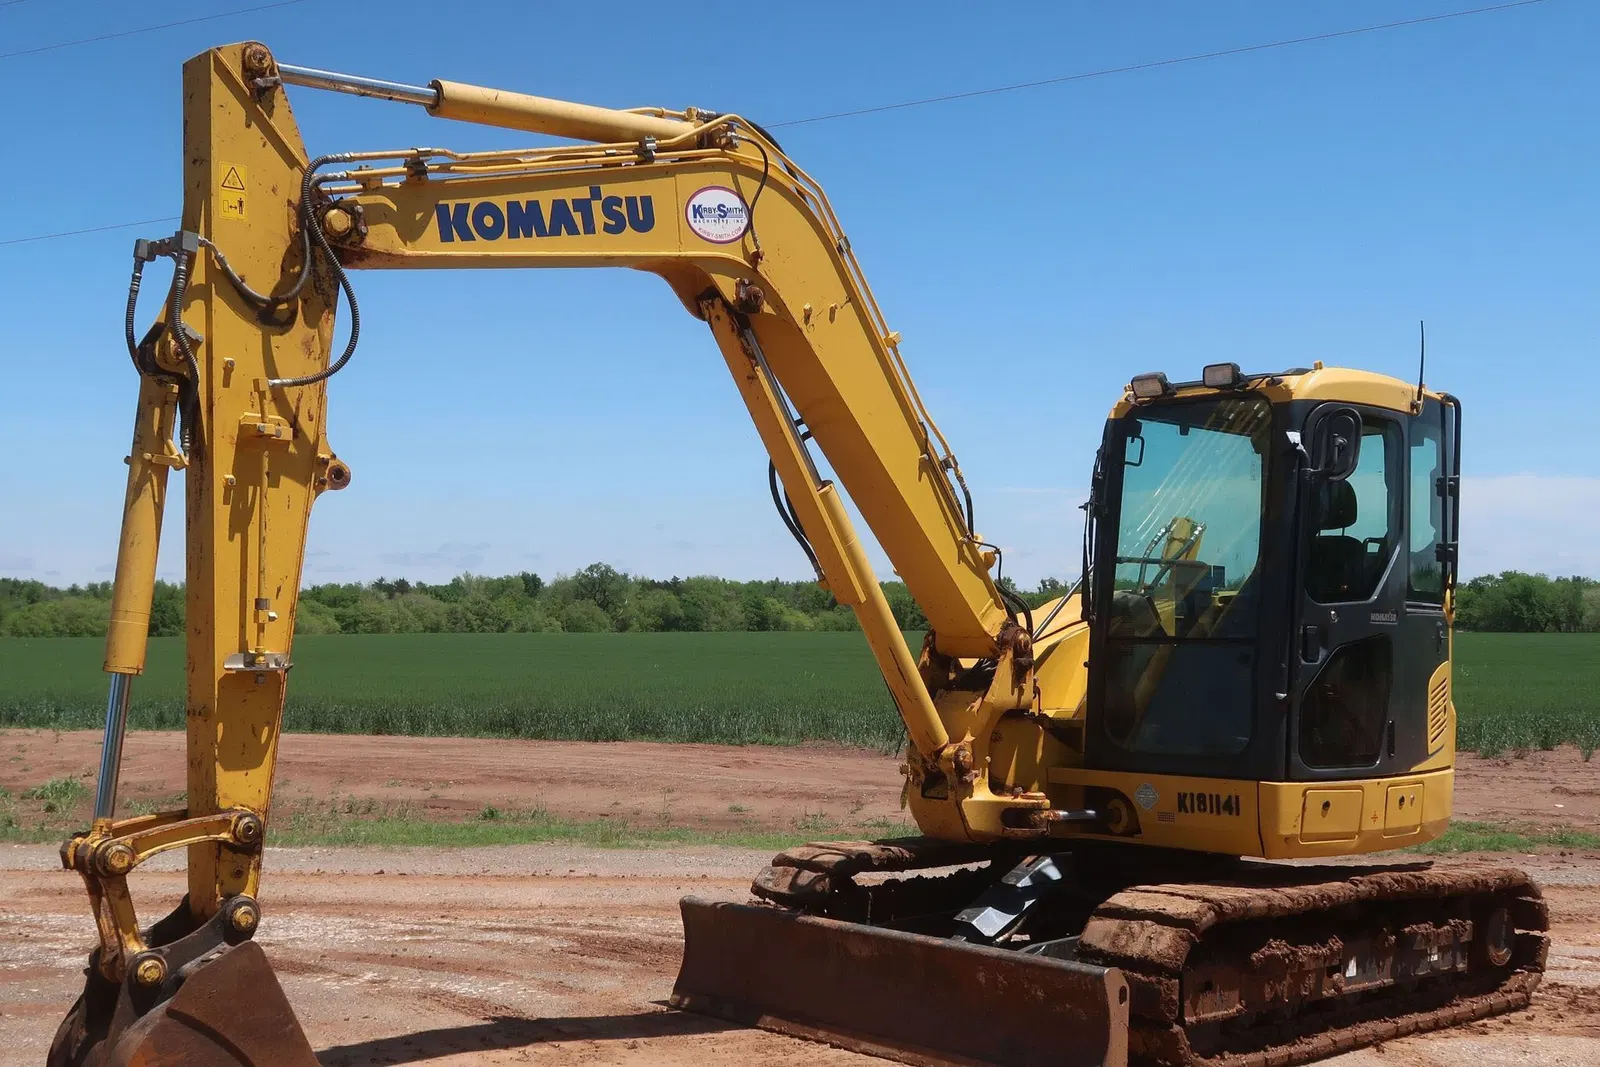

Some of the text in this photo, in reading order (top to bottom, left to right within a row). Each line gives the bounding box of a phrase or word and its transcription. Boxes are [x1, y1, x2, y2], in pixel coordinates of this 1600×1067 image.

[435, 185, 655, 242] KOMATSU
[692, 203, 743, 219] KIRBY-SMITH
[1177, 792, 1240, 816] K181141
